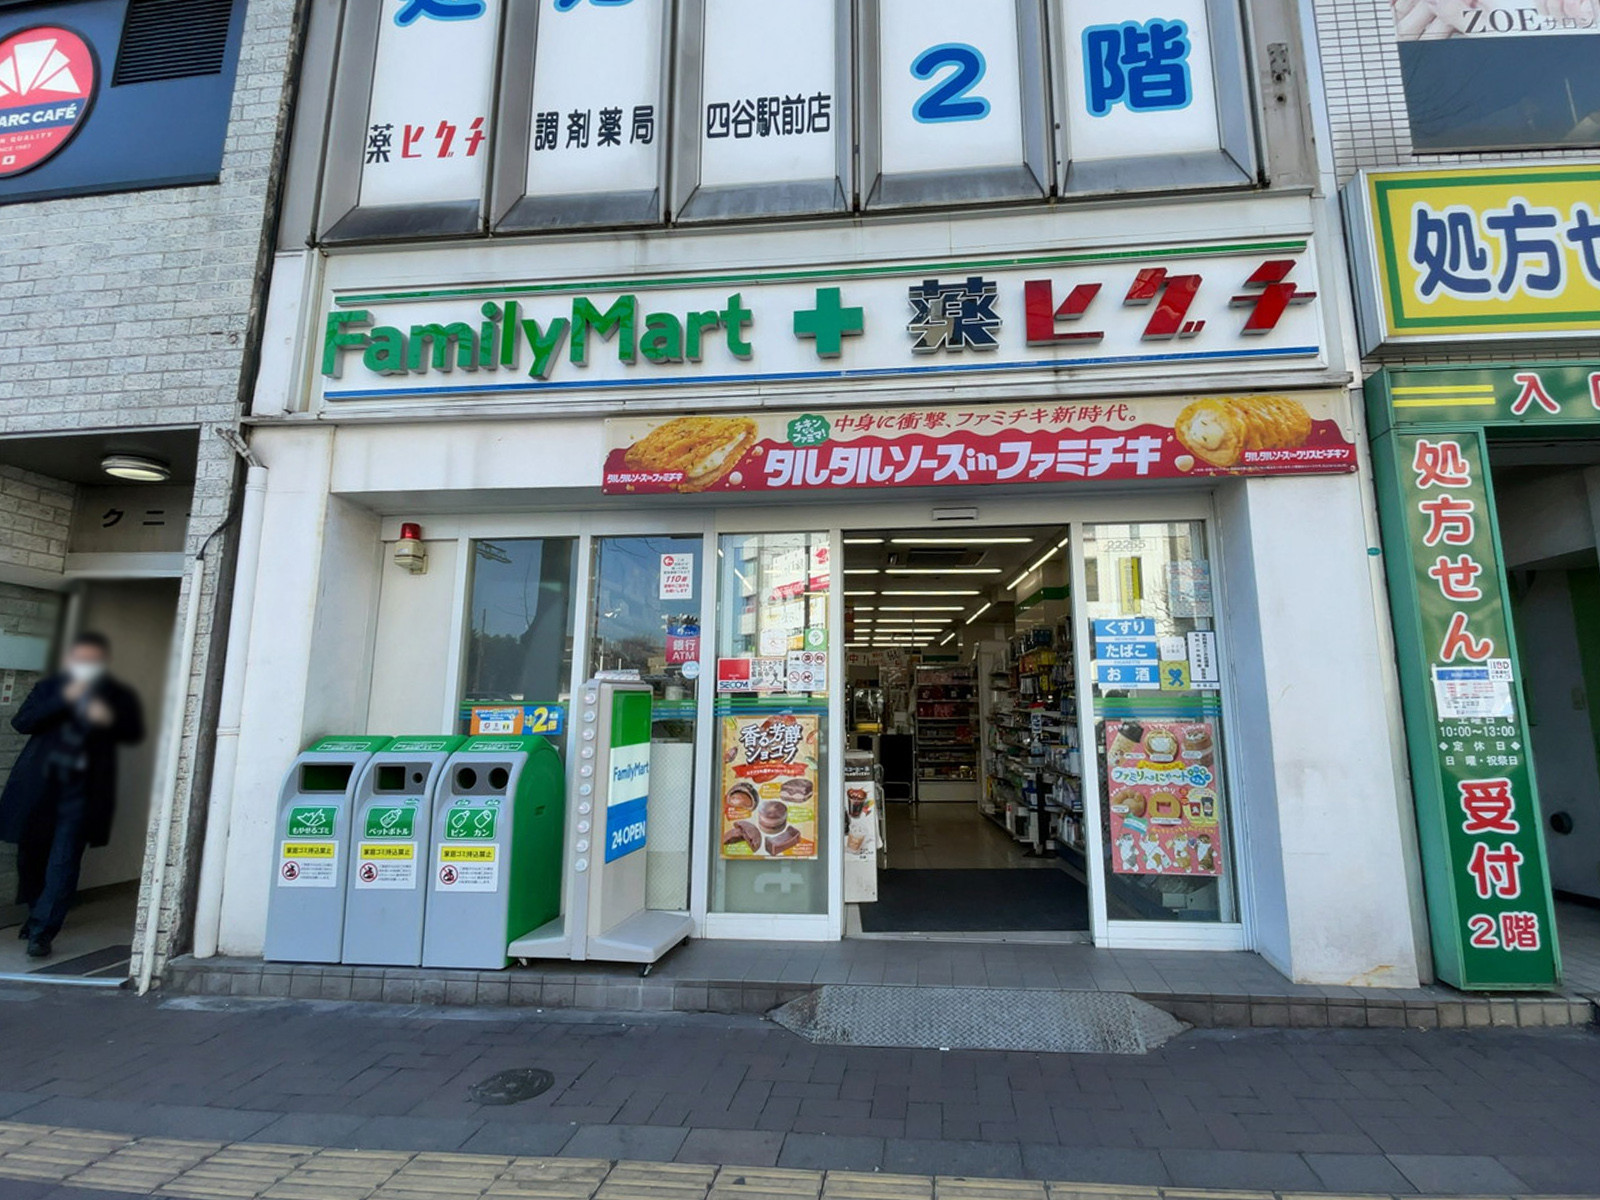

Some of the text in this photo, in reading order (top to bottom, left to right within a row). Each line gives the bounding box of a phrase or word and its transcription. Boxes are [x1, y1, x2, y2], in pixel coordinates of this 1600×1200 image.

[32, 103, 77, 123] CAFÉ
[706, 92, 831, 139] 四谷駅前店
[535, 105, 654, 151] 調剤薬局
[322, 292, 753, 380] FamilyMart
[1511, 371, 1600, 415] 入
[102, 507, 191, 528] クニ
[1412, 439, 1494, 662] 処方せん
[1105, 620, 1145, 635] くすり
[672, 651, 696, 660] ATM
[673, 639, 696, 651] 銀行
[1105, 643, 1148, 658] たばこ
[719, 681, 749, 689] SECOM
[746, 744, 797, 764] ショコラ
[613, 760, 650, 782] FamilyMart
[474, 829, 490, 837] カン
[1459, 777, 1523, 898] 受付
[1468, 911, 1540, 951] 2階
